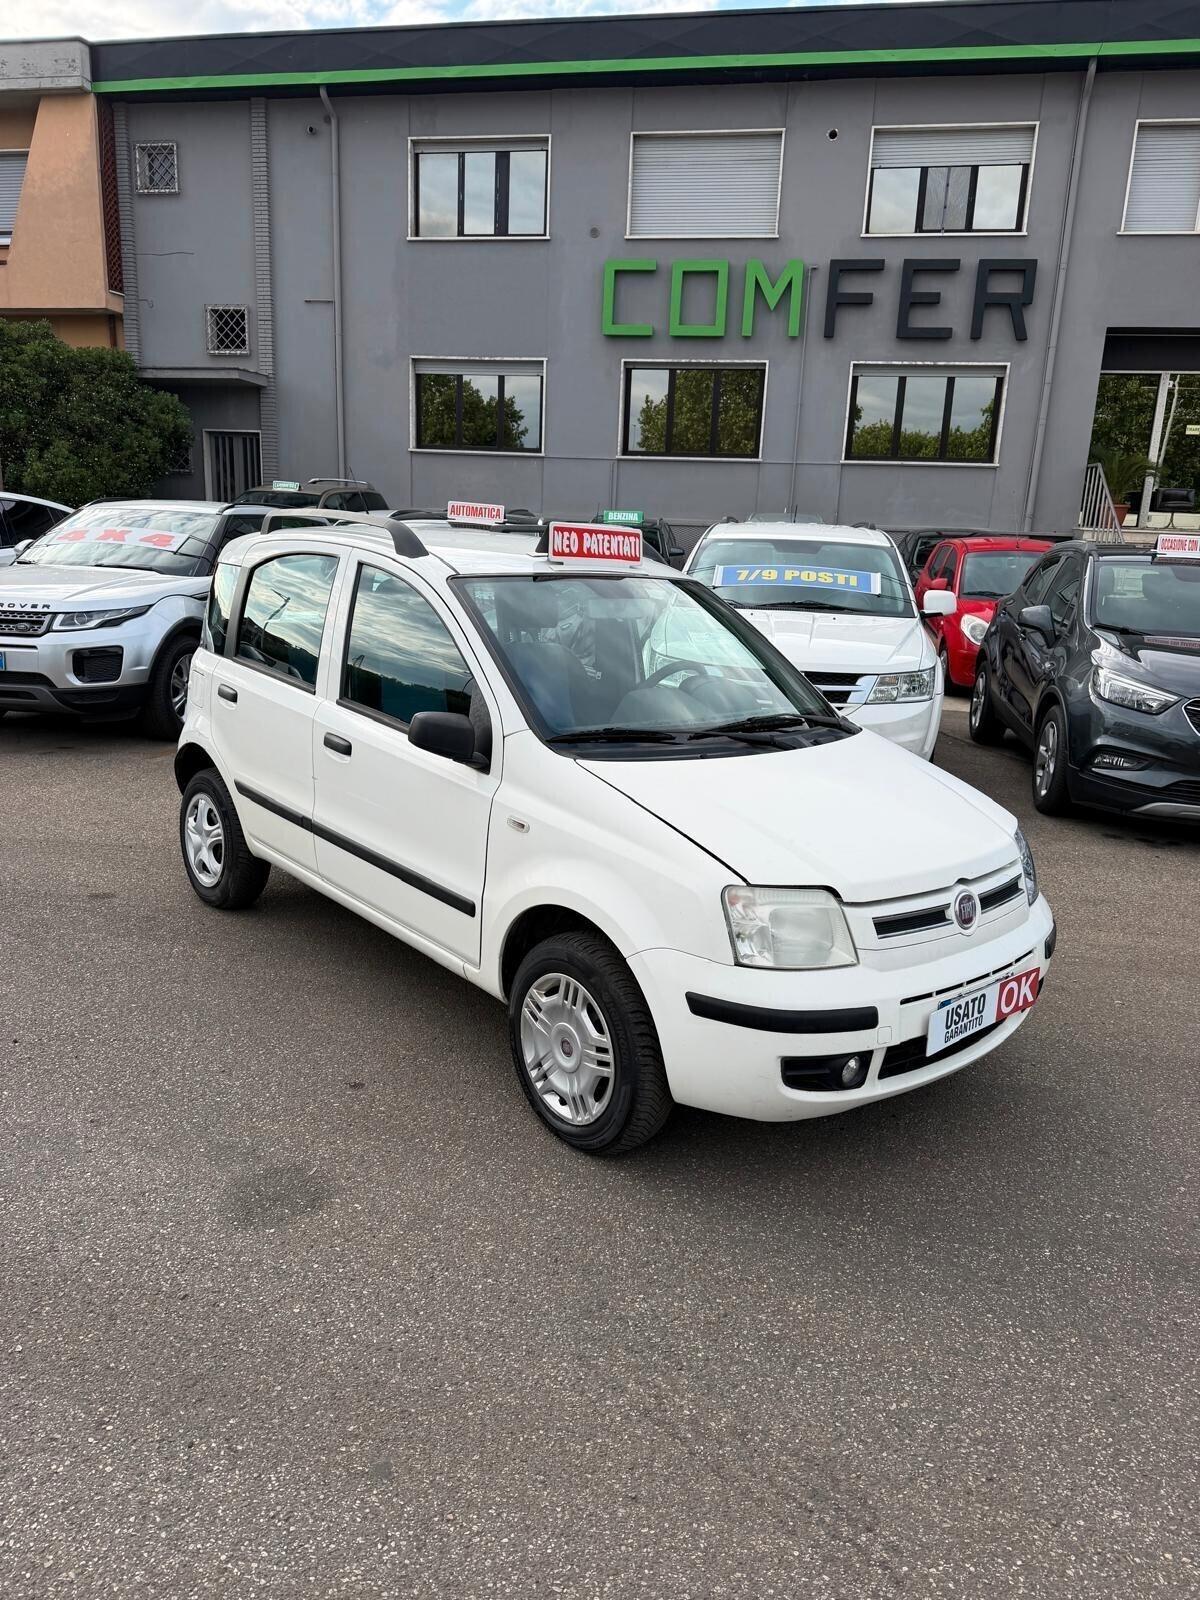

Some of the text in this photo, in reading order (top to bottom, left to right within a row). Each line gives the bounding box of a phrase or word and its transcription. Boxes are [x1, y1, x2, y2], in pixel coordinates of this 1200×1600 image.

[603, 259, 1037, 341] COMFER
[450, 504, 501, 519] AUTOMATICA
[608, 512, 638, 521] BENZINA
[554, 530, 640, 557] NEO PATENTATI
[1161, 538, 1187, 551] OCCASIONE
[736, 569, 858, 587] 7/9 POSTI
[945, 971, 1037, 1030] USATO OK
[944, 1014, 984, 1044] GARANTITO
